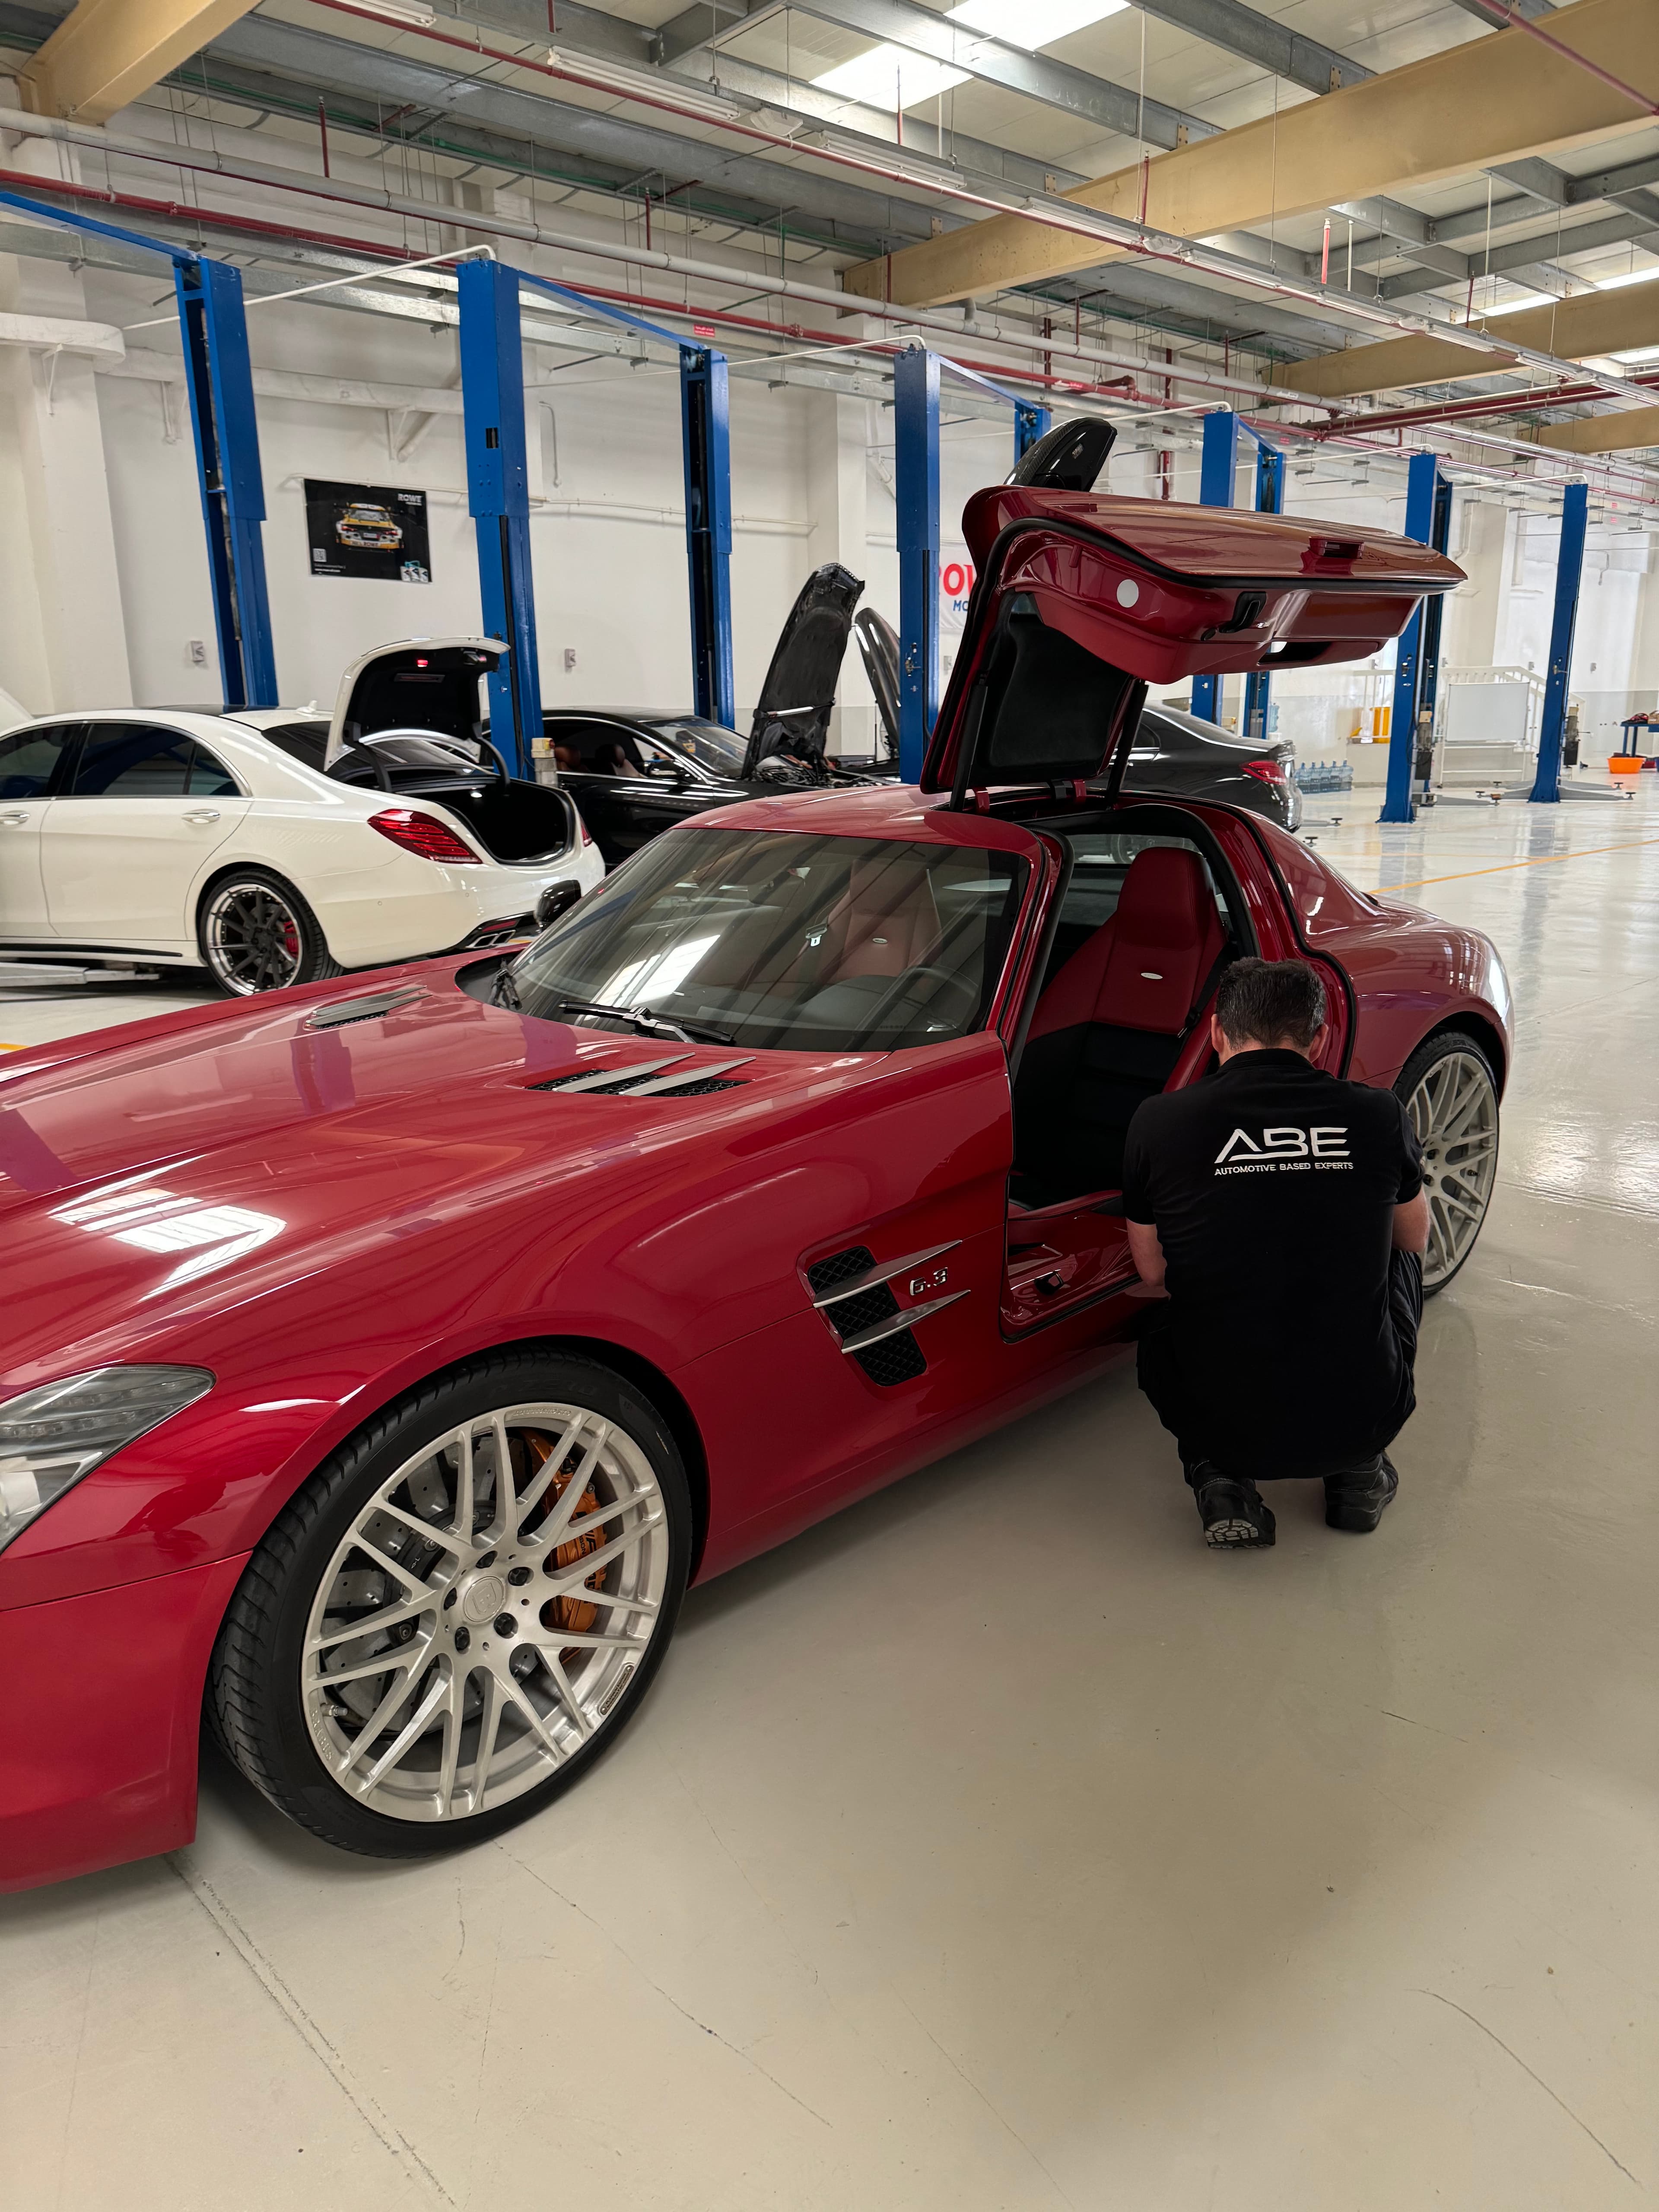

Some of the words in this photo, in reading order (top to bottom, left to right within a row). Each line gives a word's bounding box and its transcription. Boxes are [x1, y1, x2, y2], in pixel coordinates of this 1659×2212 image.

[397, 493, 422, 502] ROWE
[1214, 1164, 1277, 1176] AUTOMOTIVE
[909, 1267, 948, 1296] 6.3
